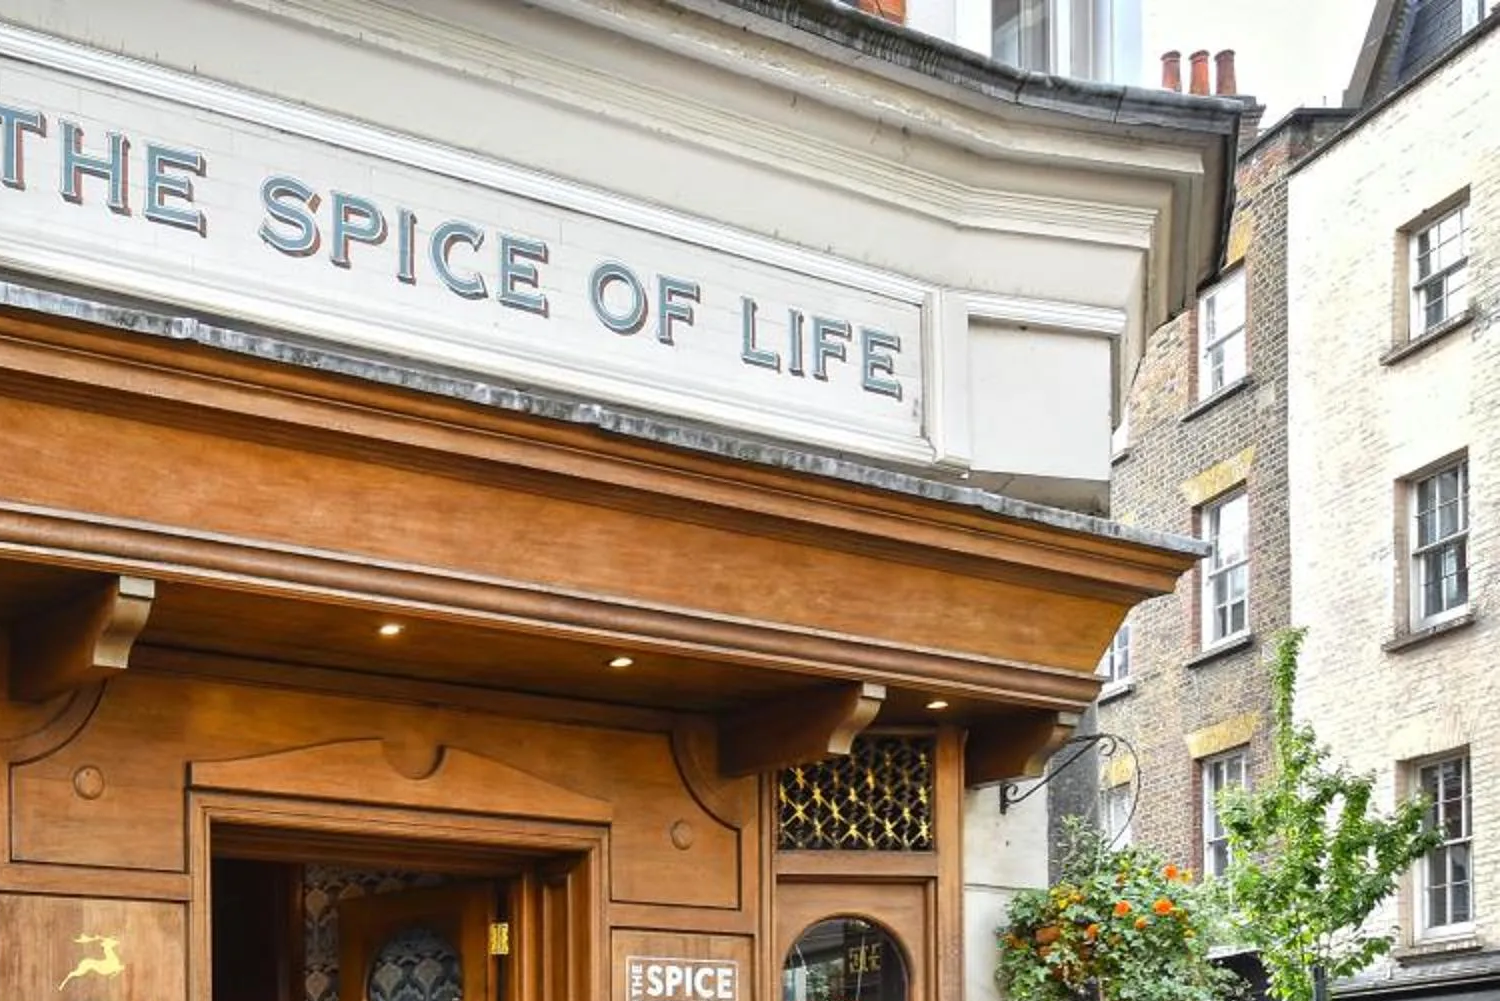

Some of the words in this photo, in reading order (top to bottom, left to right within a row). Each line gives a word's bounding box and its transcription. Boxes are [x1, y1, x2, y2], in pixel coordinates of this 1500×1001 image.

[258, 173, 550, 318] SPICE
[586, 257, 699, 346] OF
[739, 294, 903, 402] LIFE
[631, 964, 643, 997] THE
[646, 964, 733, 999] SPICE
